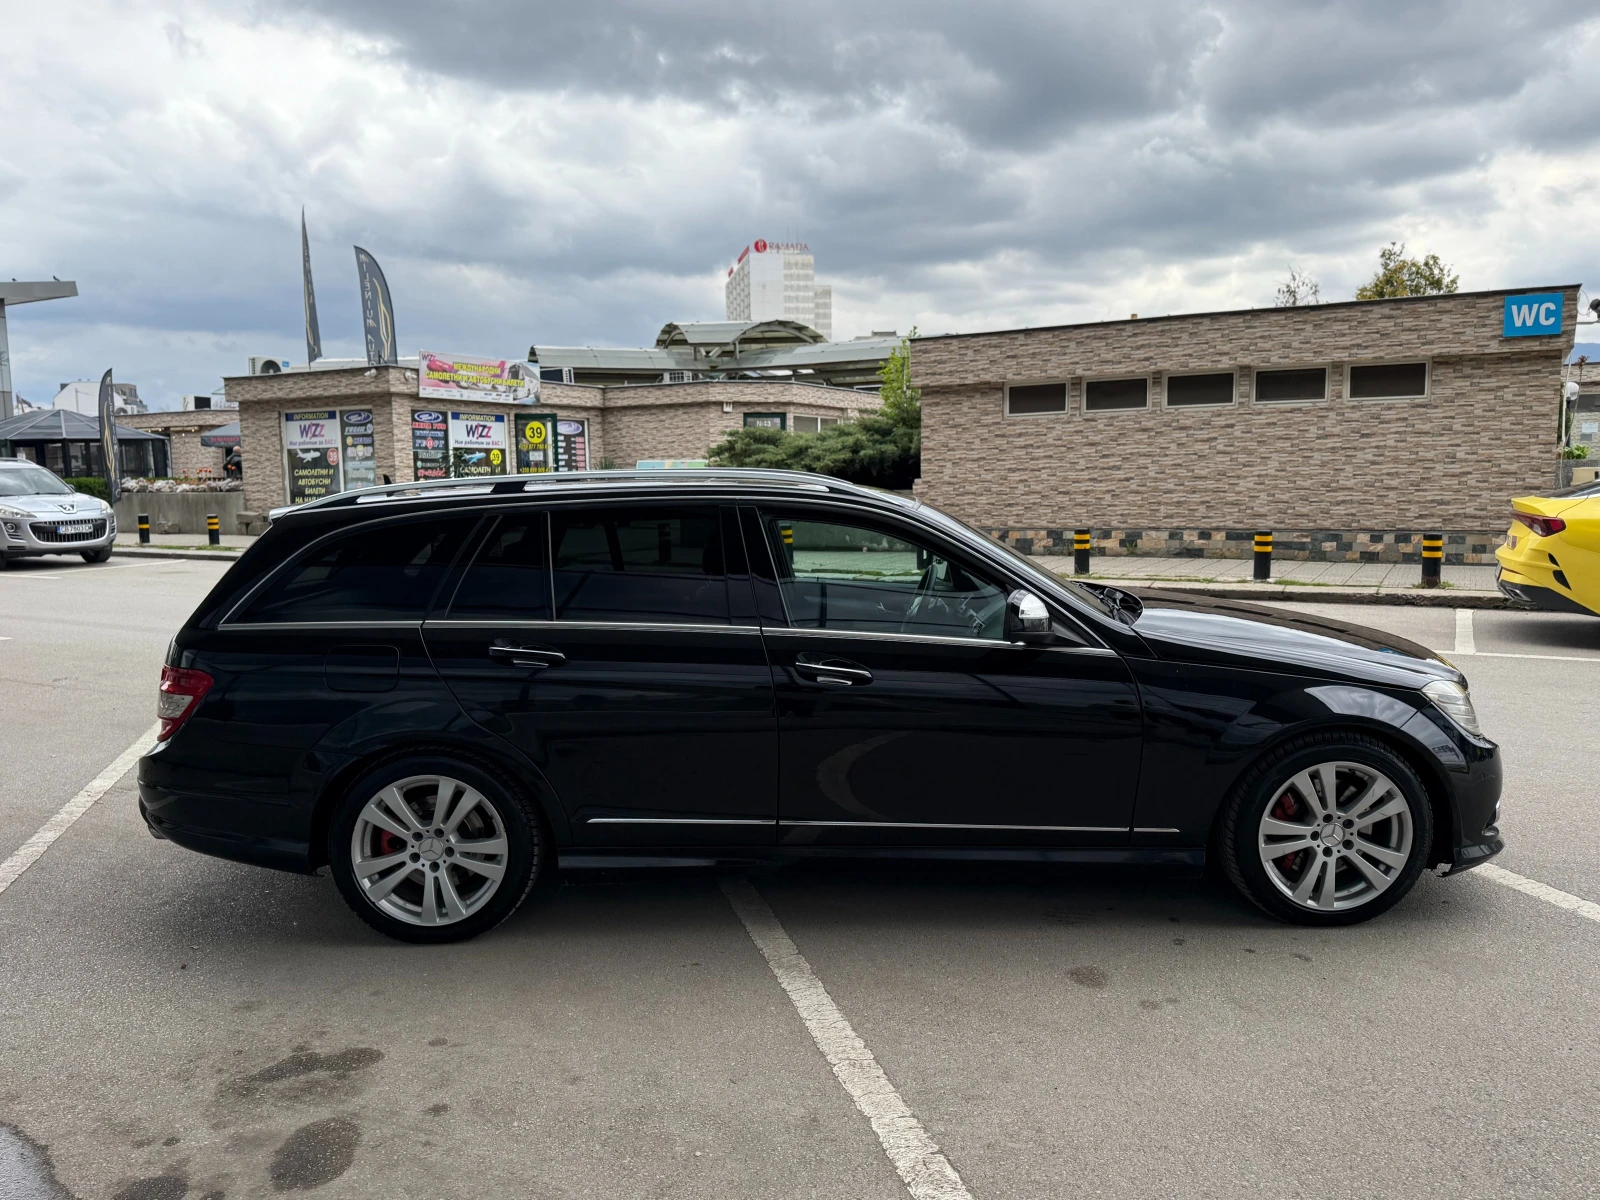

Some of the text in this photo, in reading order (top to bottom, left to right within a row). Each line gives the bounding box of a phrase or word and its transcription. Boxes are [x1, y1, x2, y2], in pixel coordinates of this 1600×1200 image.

[768, 242, 808, 250] RAMADA
[1511, 302, 1556, 327] WC
[453, 362, 501, 374] МЕЖДУНАРОДНИ
[425, 371, 462, 382] САМОЛЕТНИ
[469, 376, 502, 385] АВТОБУСНИ
[294, 412, 328, 420] INFORMATION
[300, 422, 325, 440] WIZZ
[466, 422, 492, 440] WIZZ
[529, 427, 542, 438] 39
[329, 452, 338, 460] 39
